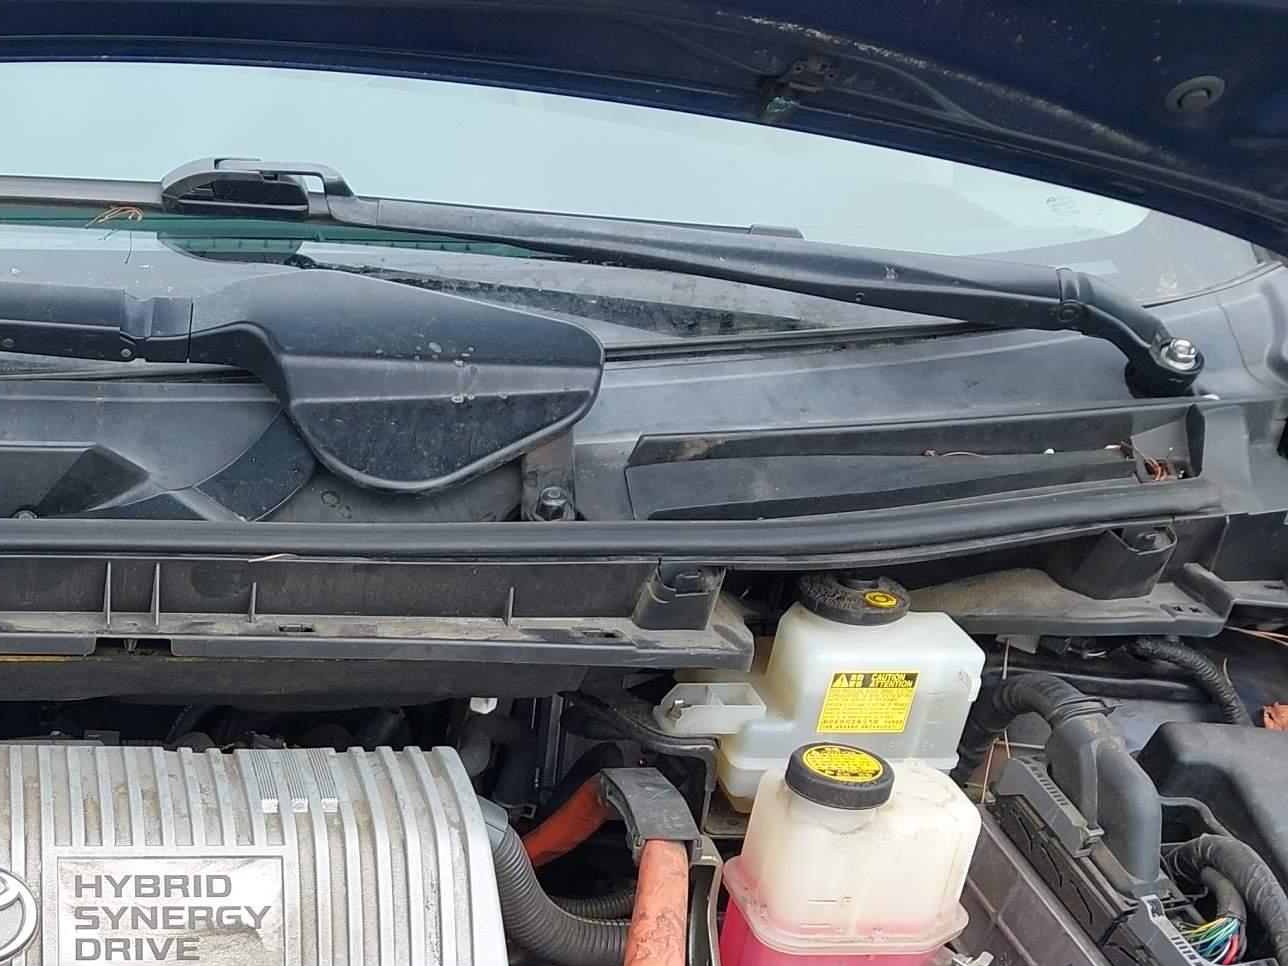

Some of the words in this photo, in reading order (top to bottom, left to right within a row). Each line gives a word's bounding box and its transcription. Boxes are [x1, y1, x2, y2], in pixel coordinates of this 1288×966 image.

[869, 680, 913, 688] ATTENTION
[871, 673, 906, 681] CAUTION
[74, 874, 233, 898] HYBRID
[74, 905, 273, 930] SYNERGY
[75, 937, 201, 961] DRIVE
